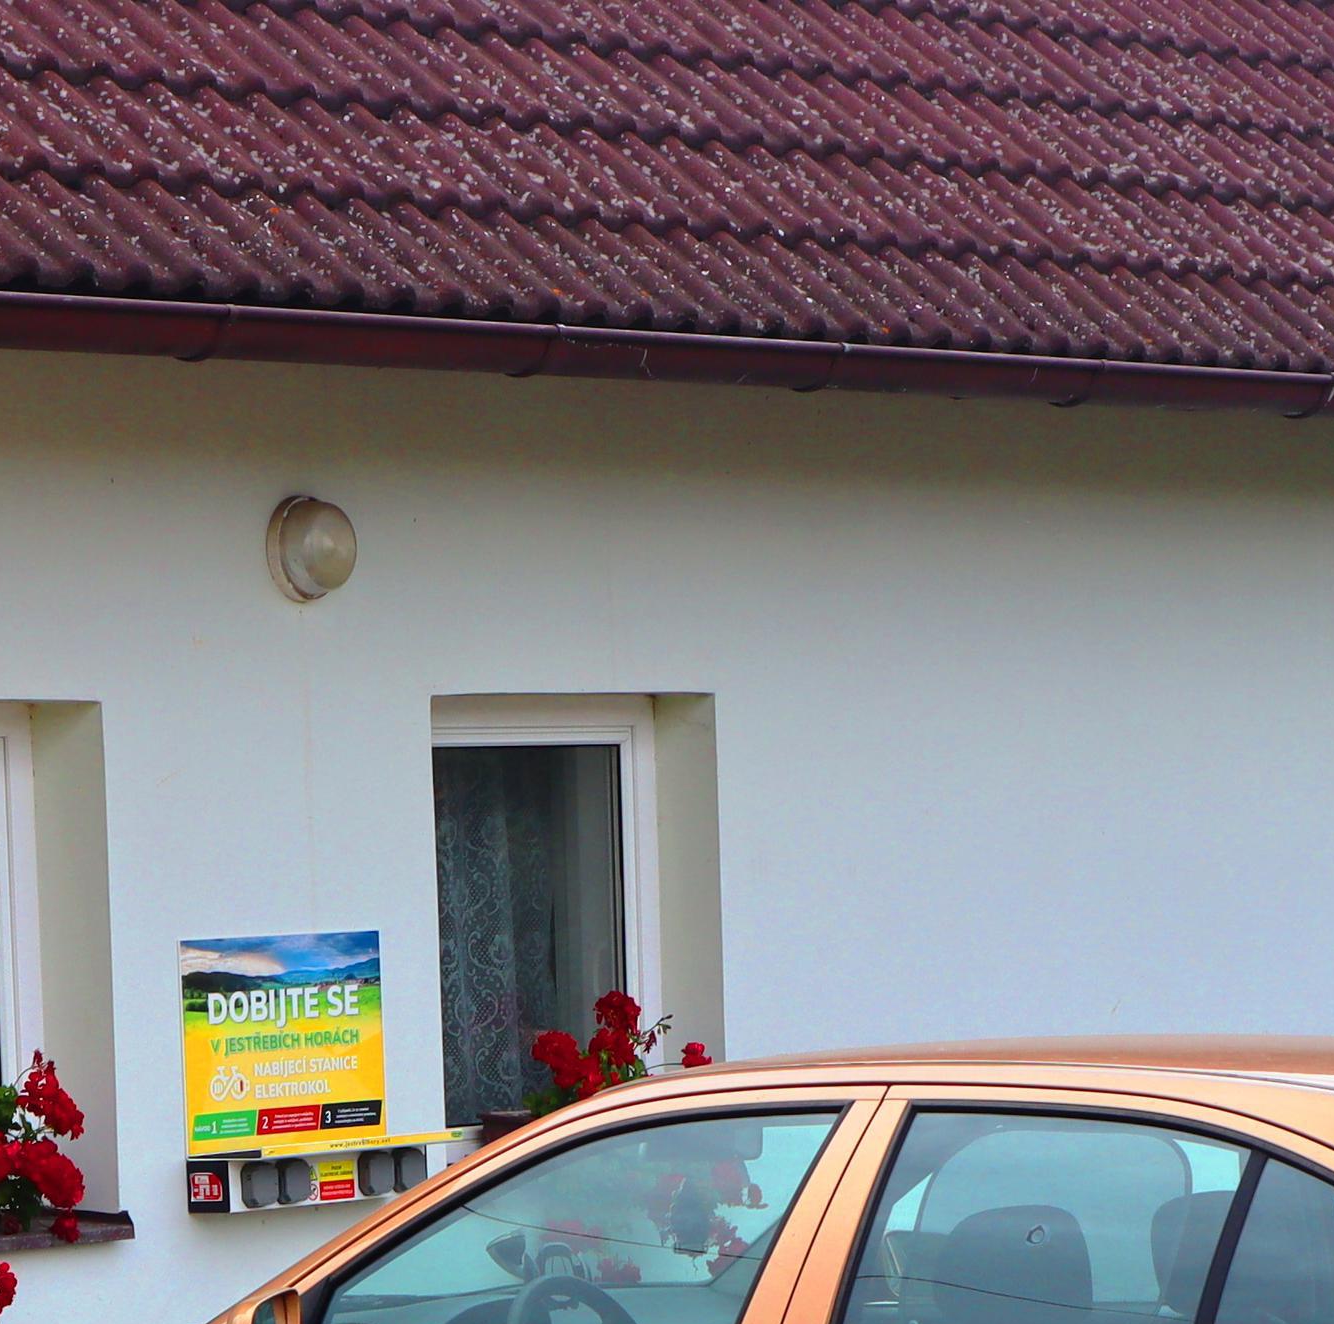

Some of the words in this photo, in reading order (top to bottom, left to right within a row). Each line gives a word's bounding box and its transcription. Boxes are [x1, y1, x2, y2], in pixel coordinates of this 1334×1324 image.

[207, 986, 320, 1028] DOBIJTE
[326, 984, 360, 1017] SE
[210, 1038, 221, 1055] V
[224, 1031, 301, 1057] JESTŘEBÍCH
[304, 1026, 359, 1048] HORÁCH
[254, 1056, 306, 1078] NABÍJECÍ
[309, 1055, 358, 1073] STANICE
[254, 1079, 331, 1099] ELEKTROKOL
[211, 1120, 218, 1134] 1
[261, 1116, 269, 1130] 2
[324, 1110, 332, 1124] 3
